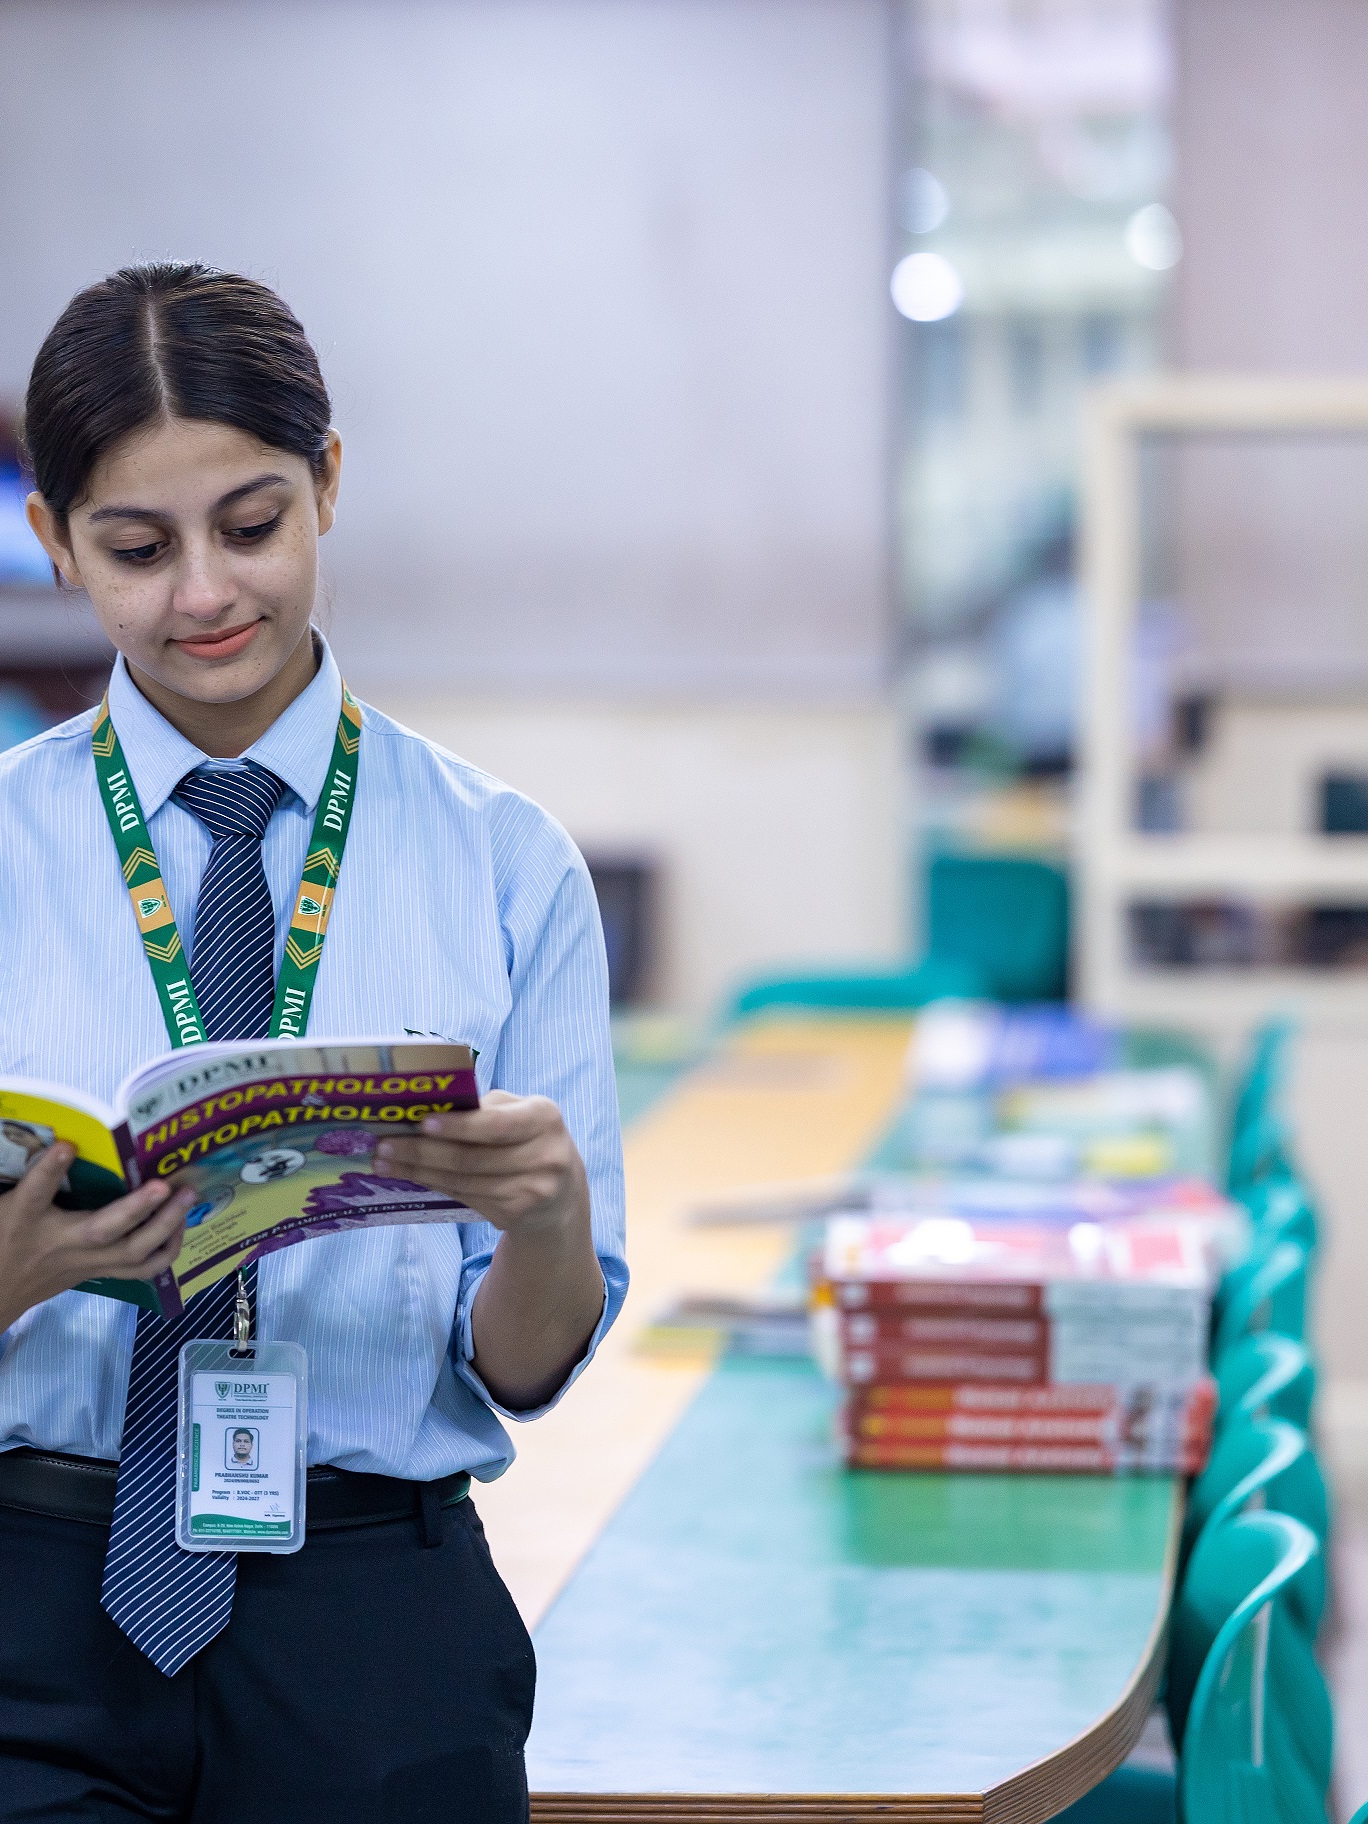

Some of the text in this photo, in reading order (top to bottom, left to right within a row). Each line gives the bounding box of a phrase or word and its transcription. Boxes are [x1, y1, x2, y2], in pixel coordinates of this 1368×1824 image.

[106, 768, 140, 833] DPMI
[322, 768, 352, 832] DPMI
[166, 977, 203, 1046] DPMI
[144, 1073, 456, 1152] HISTOPATHOLOGY
[157, 1102, 454, 1176] CYTOPATHOLOGY
[234, 1383, 268, 1394] DPMI
